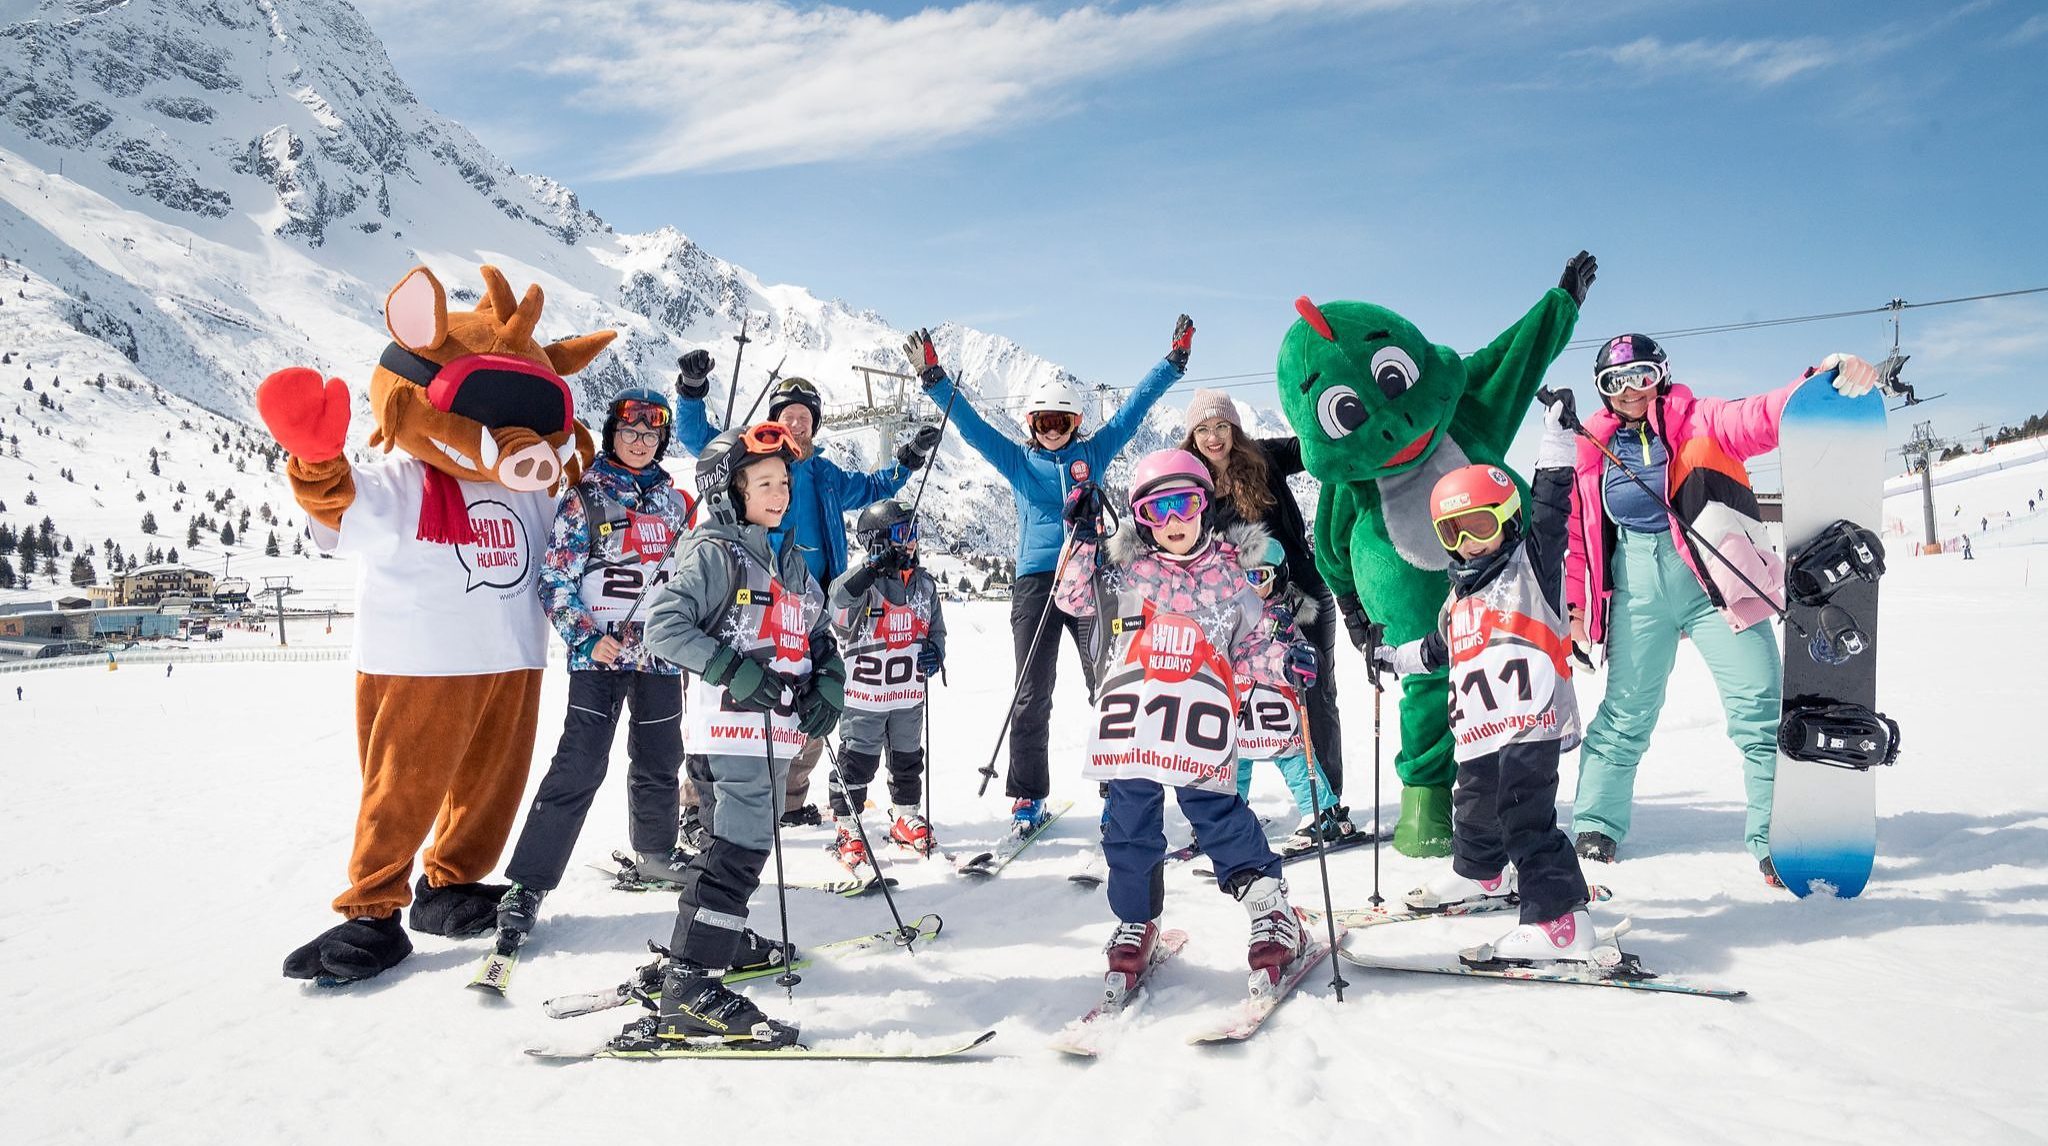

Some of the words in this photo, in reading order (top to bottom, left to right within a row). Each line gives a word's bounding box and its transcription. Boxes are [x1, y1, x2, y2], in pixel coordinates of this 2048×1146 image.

[471, 518, 516, 548] WILD
[637, 523, 666, 542] WILD
[476, 551, 518, 568] HOLIDAYS
[602, 567, 677, 600] 21
[889, 612, 911, 631] WILD
[1152, 624, 1197, 655] WILD
[1149, 655, 1192, 673] HOLIDAYS
[845, 688, 925, 703] www.wildholida
[1099, 693, 1230, 751] 210
